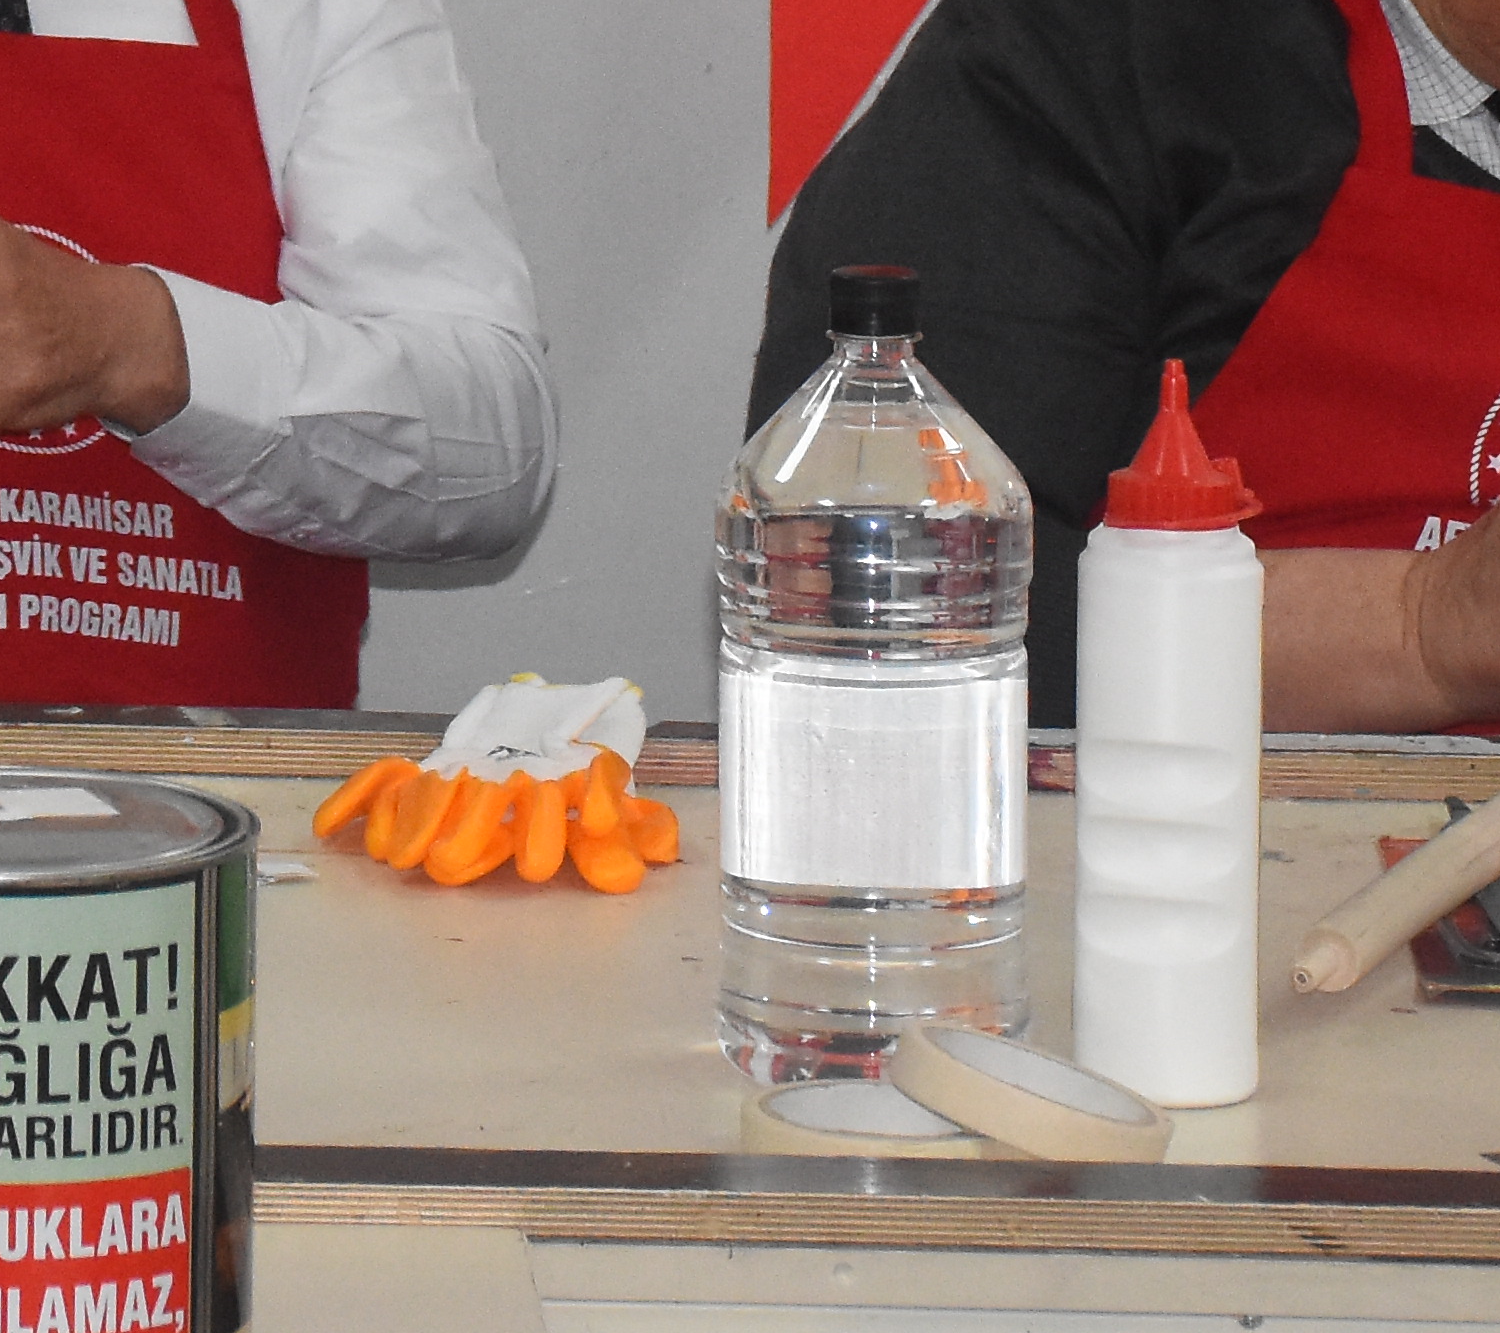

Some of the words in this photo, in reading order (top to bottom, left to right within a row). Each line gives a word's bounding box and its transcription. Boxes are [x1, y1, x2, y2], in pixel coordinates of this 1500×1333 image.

[69, 546, 108, 584] VE
[118, 552, 244, 602] SANATLA
[20, 593, 180, 647] PROGRAMI
